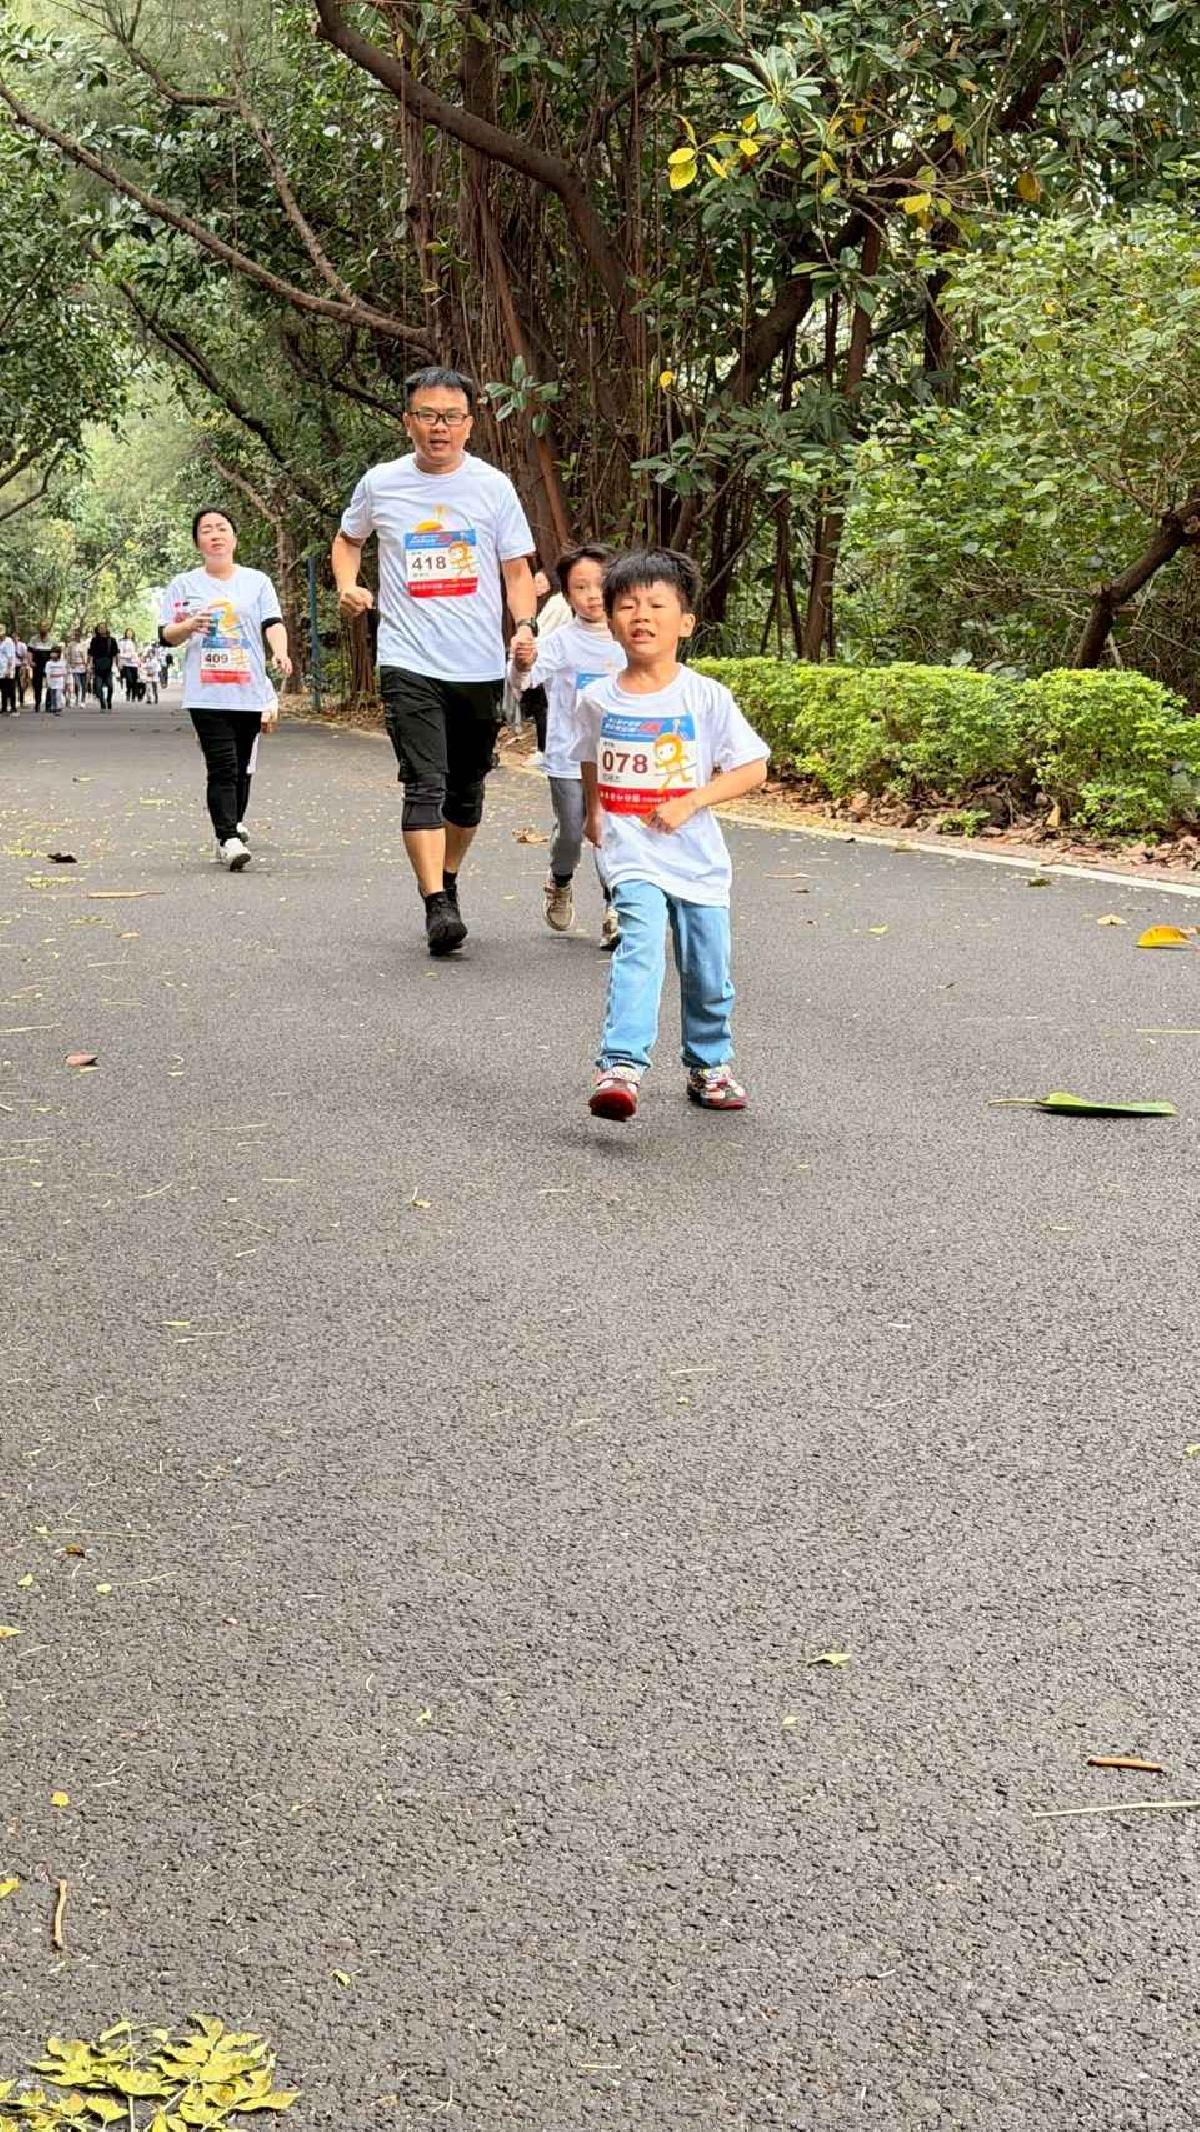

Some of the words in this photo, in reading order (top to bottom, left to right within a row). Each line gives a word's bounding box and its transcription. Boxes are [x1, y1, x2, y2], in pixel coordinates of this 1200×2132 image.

[411, 556, 447, 570] 418
[205, 653, 228, 663] 409
[602, 751, 648, 774] 078
